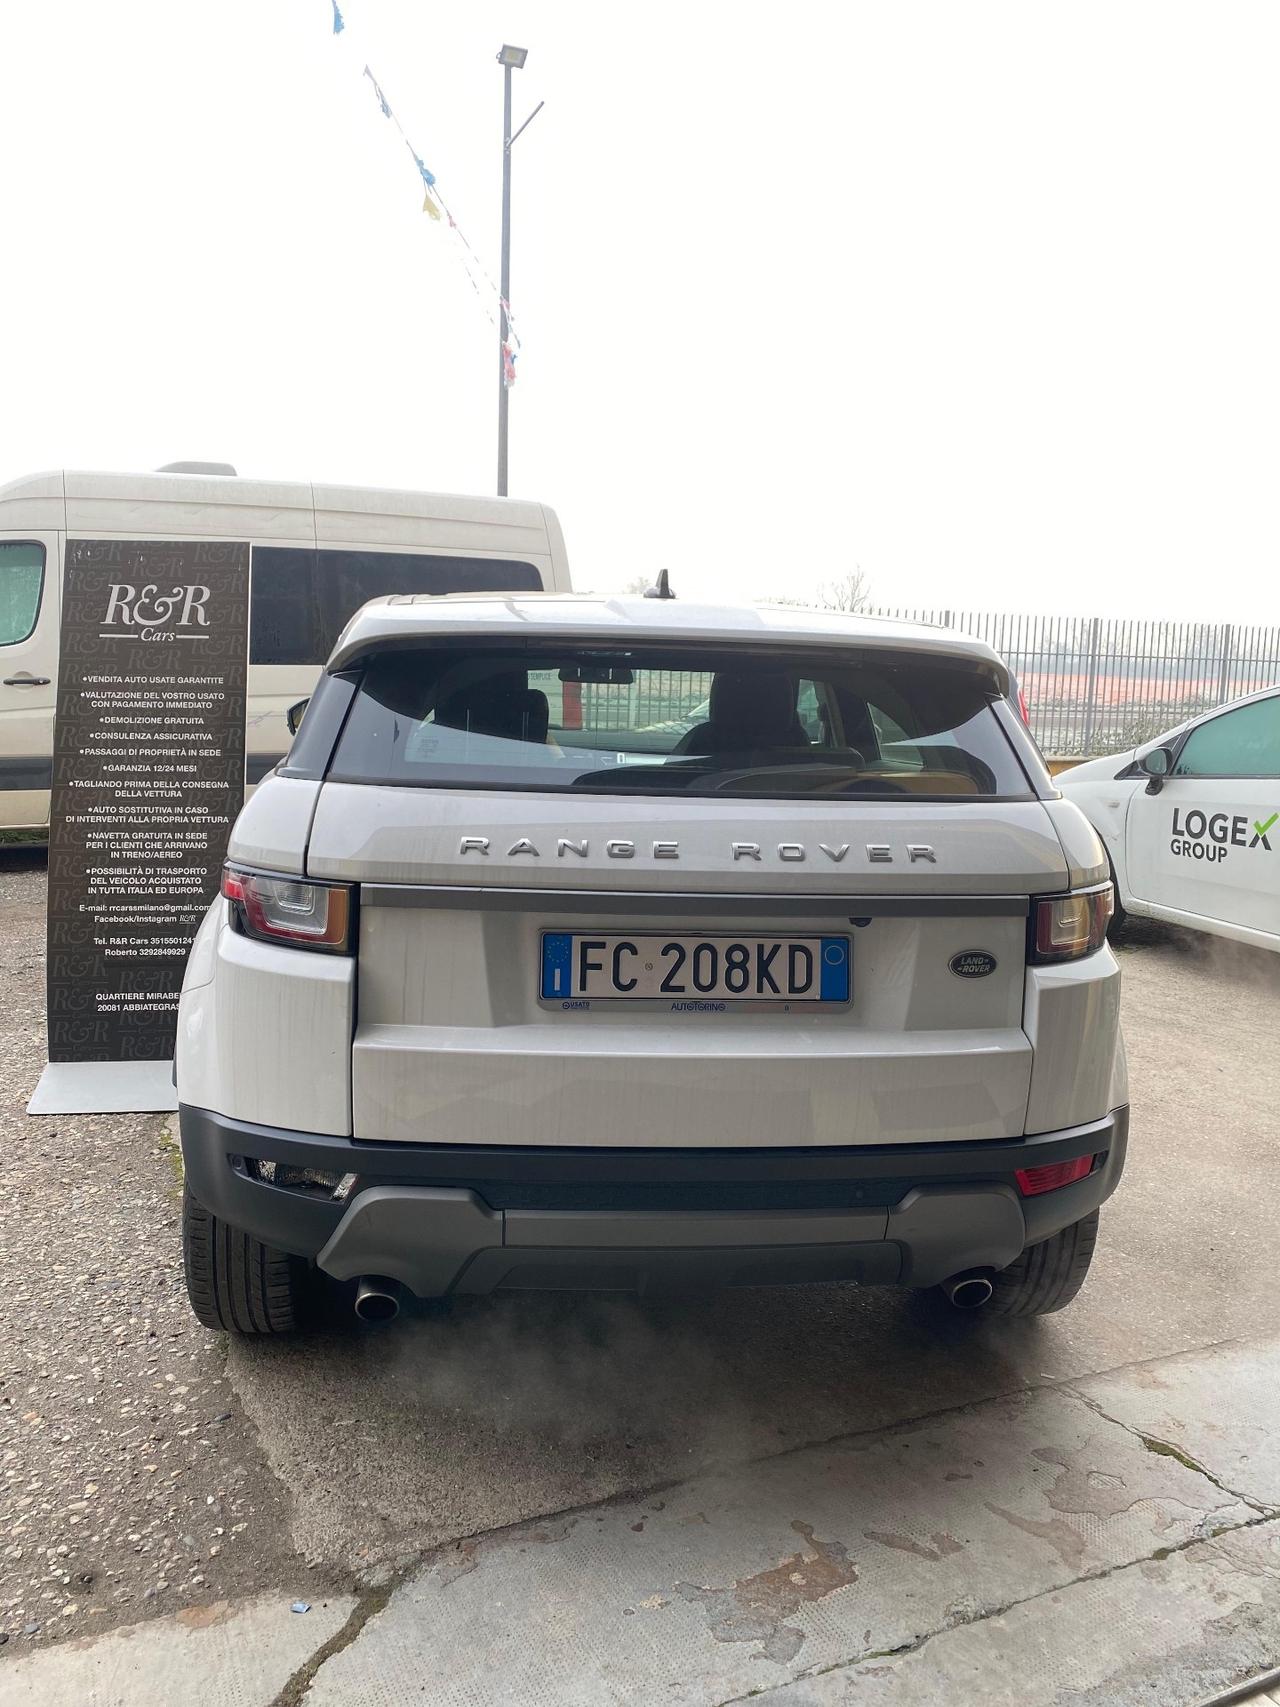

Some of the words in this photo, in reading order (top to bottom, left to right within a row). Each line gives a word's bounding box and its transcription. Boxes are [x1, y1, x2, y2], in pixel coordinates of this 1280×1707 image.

[100, 584, 210, 626] R&R
[140, 627, 175, 642] Cars
[149, 676, 176, 684] USATE
[85, 691, 141, 699] VALUTAZIONE
[161, 692, 196, 700] VOSTRO
[112, 701, 164, 709] PAGAMENTO
[95, 732, 151, 740] CONSULENZA
[153, 732, 212, 740] ASSICURATIVA
[85, 748, 127, 756] PASSAGGI
[139, 747, 186, 756] PROPRIETÀ
[199, 749, 221, 757] SEDE
[108, 764, 151, 772] GARANZIA
[153, 764, 174, 772] 12/24
[176, 764, 197, 772] MESI
[74, 780, 122, 788] TAGLIANDO
[124, 780, 151, 788] PRIMA
[153, 780, 180, 788] DELLA
[115, 790, 142, 798] DELLA
[143, 790, 182, 798] VETTURA
[92, 806, 116, 814] AUTO
[118, 806, 172, 814] SOSTITUTIVA
[174, 806, 183, 814] IN
[185, 806, 208, 814] CASO
[460, 836, 680, 860] RANGE
[732, 842, 937, 863] ROVER
[1170, 838, 1228, 863] GROUP
[91, 866, 143, 875] POSSIBILITÀ
[90, 877, 106, 885] DEL
[108, 877, 146, 885] VEICOLO
[148, 877, 201, 885] ACQUISTATO
[79, 904, 108, 912] E-mail:
[94, 915, 177, 924] Facebook/Instagram
[94, 937, 108, 945] Tel.
[109, 937, 128, 945] R&R
[130, 937, 149, 945] Cars
[105, 948, 137, 956] Roberto
[961, 957, 985, 966] LAND
[579, 941, 638, 992] FC
[660, 942, 813, 994] 208KD
[963, 964, 990, 973] ROVER
[554, 968, 561, 991] I
[96, 993, 145, 1001] QUARTIERE
[147, 993, 180, 1001] MIRABE
